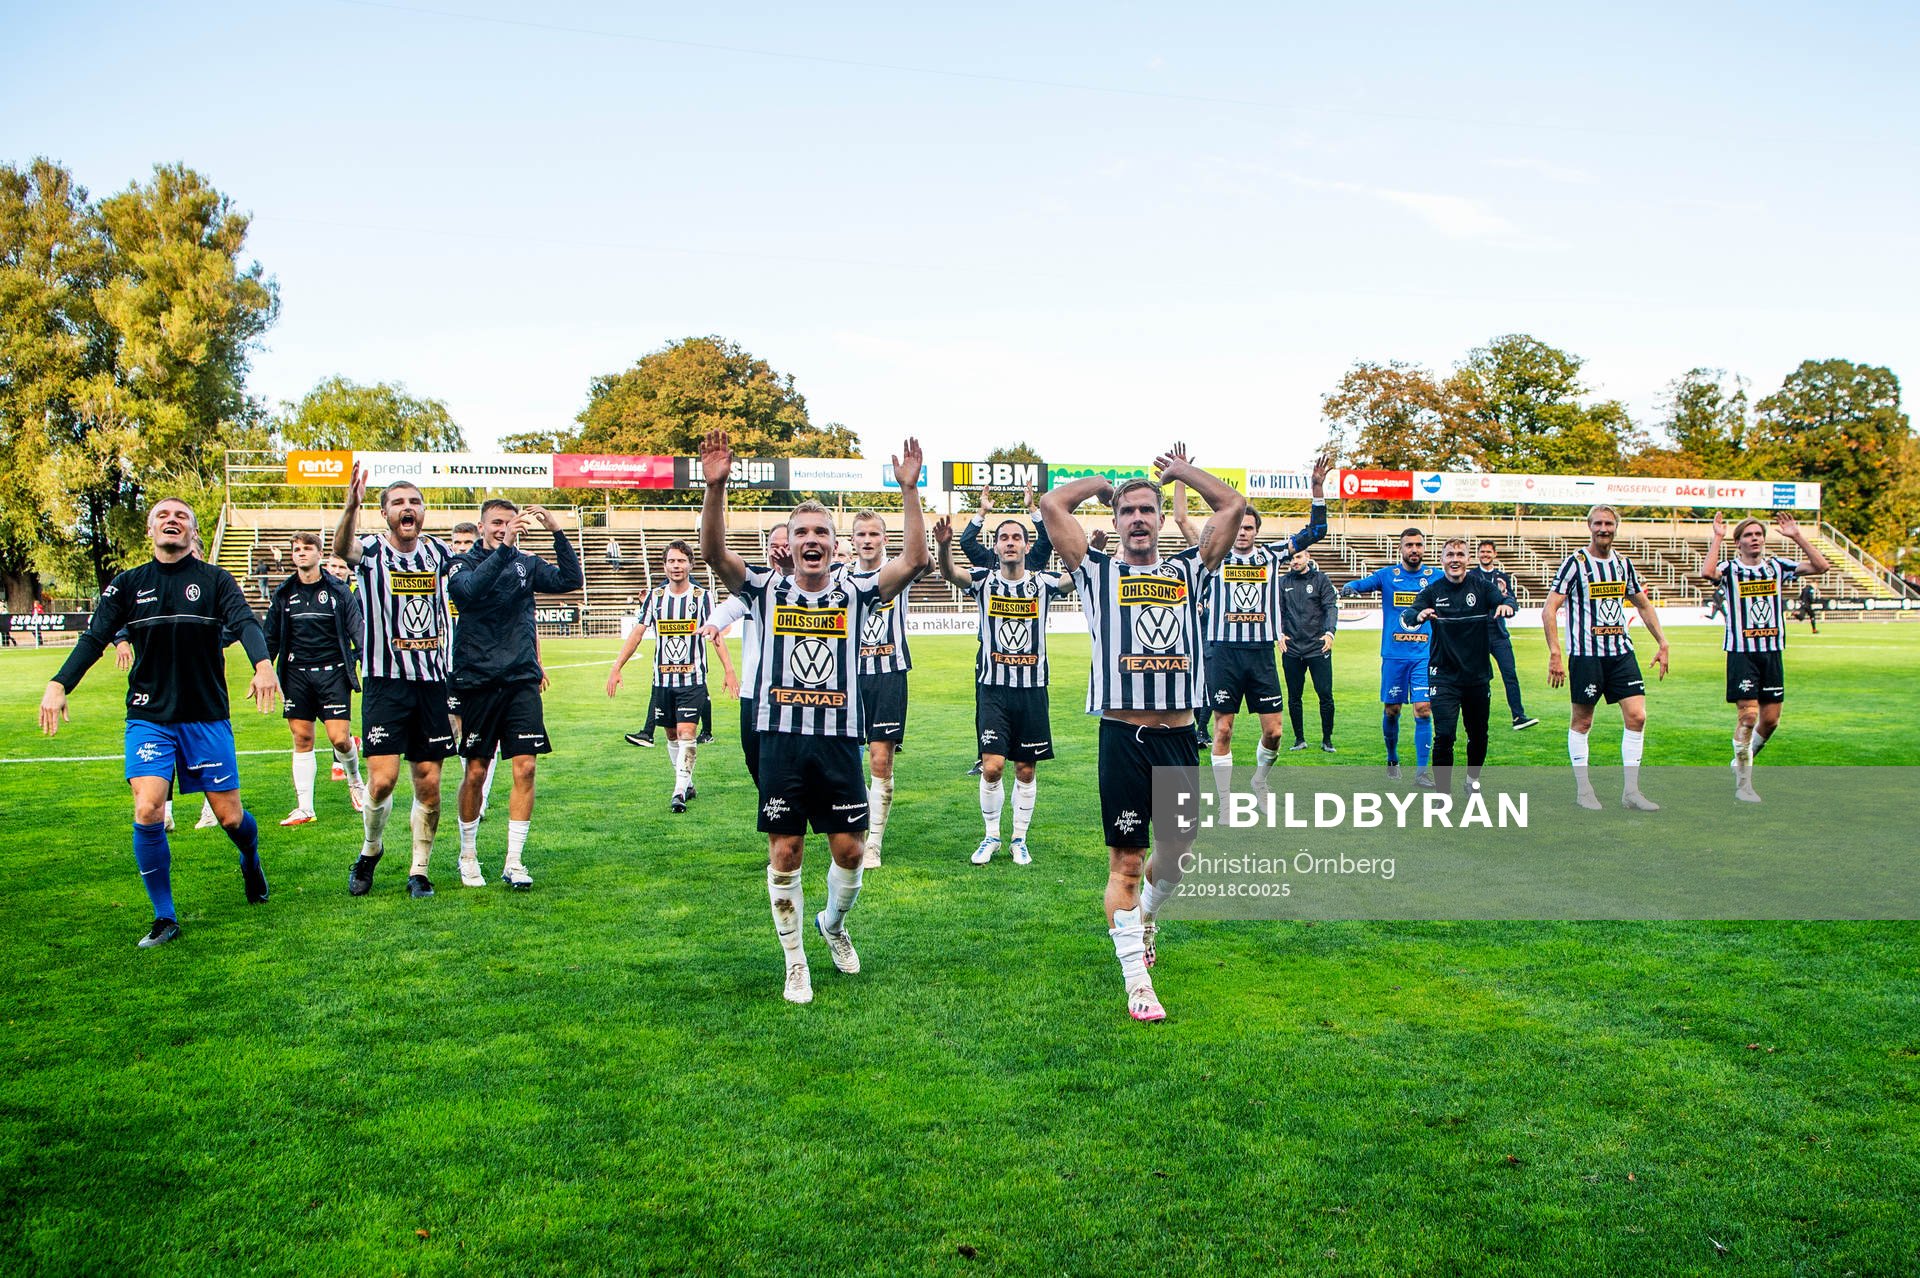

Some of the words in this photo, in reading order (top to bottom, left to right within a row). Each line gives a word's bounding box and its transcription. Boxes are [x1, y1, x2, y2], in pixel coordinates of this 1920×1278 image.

[298, 458, 343, 472] renta
[688, 458, 776, 482] Insign
[794, 470, 863, 479] Handelsbanken
[972, 463, 1038, 486] BBM
[1250, 475, 1266, 489] GO
[1270, 473, 1311, 490] BILTVÄ
[1607, 484, 1667, 493] RINGSERVICE
[1717, 487, 1746, 497] CITY
[1225, 570, 1260, 578] OHLSSONS
[393, 577, 432, 589] OHLSSONS
[1122, 584, 1177, 600] OHLSSONS
[992, 602, 1030, 613] OHLSSONS
[777, 614, 835, 629] OHLSSONS
[1224, 613, 1266, 622] TEAMAB
[860, 645, 895, 656] AMAB
[992, 653, 1037, 665] TEAMAB
[1120, 656, 1190, 671] TEAMAB
[133, 693, 149, 705] 29
[770, 688, 846, 706] TEAMAB
